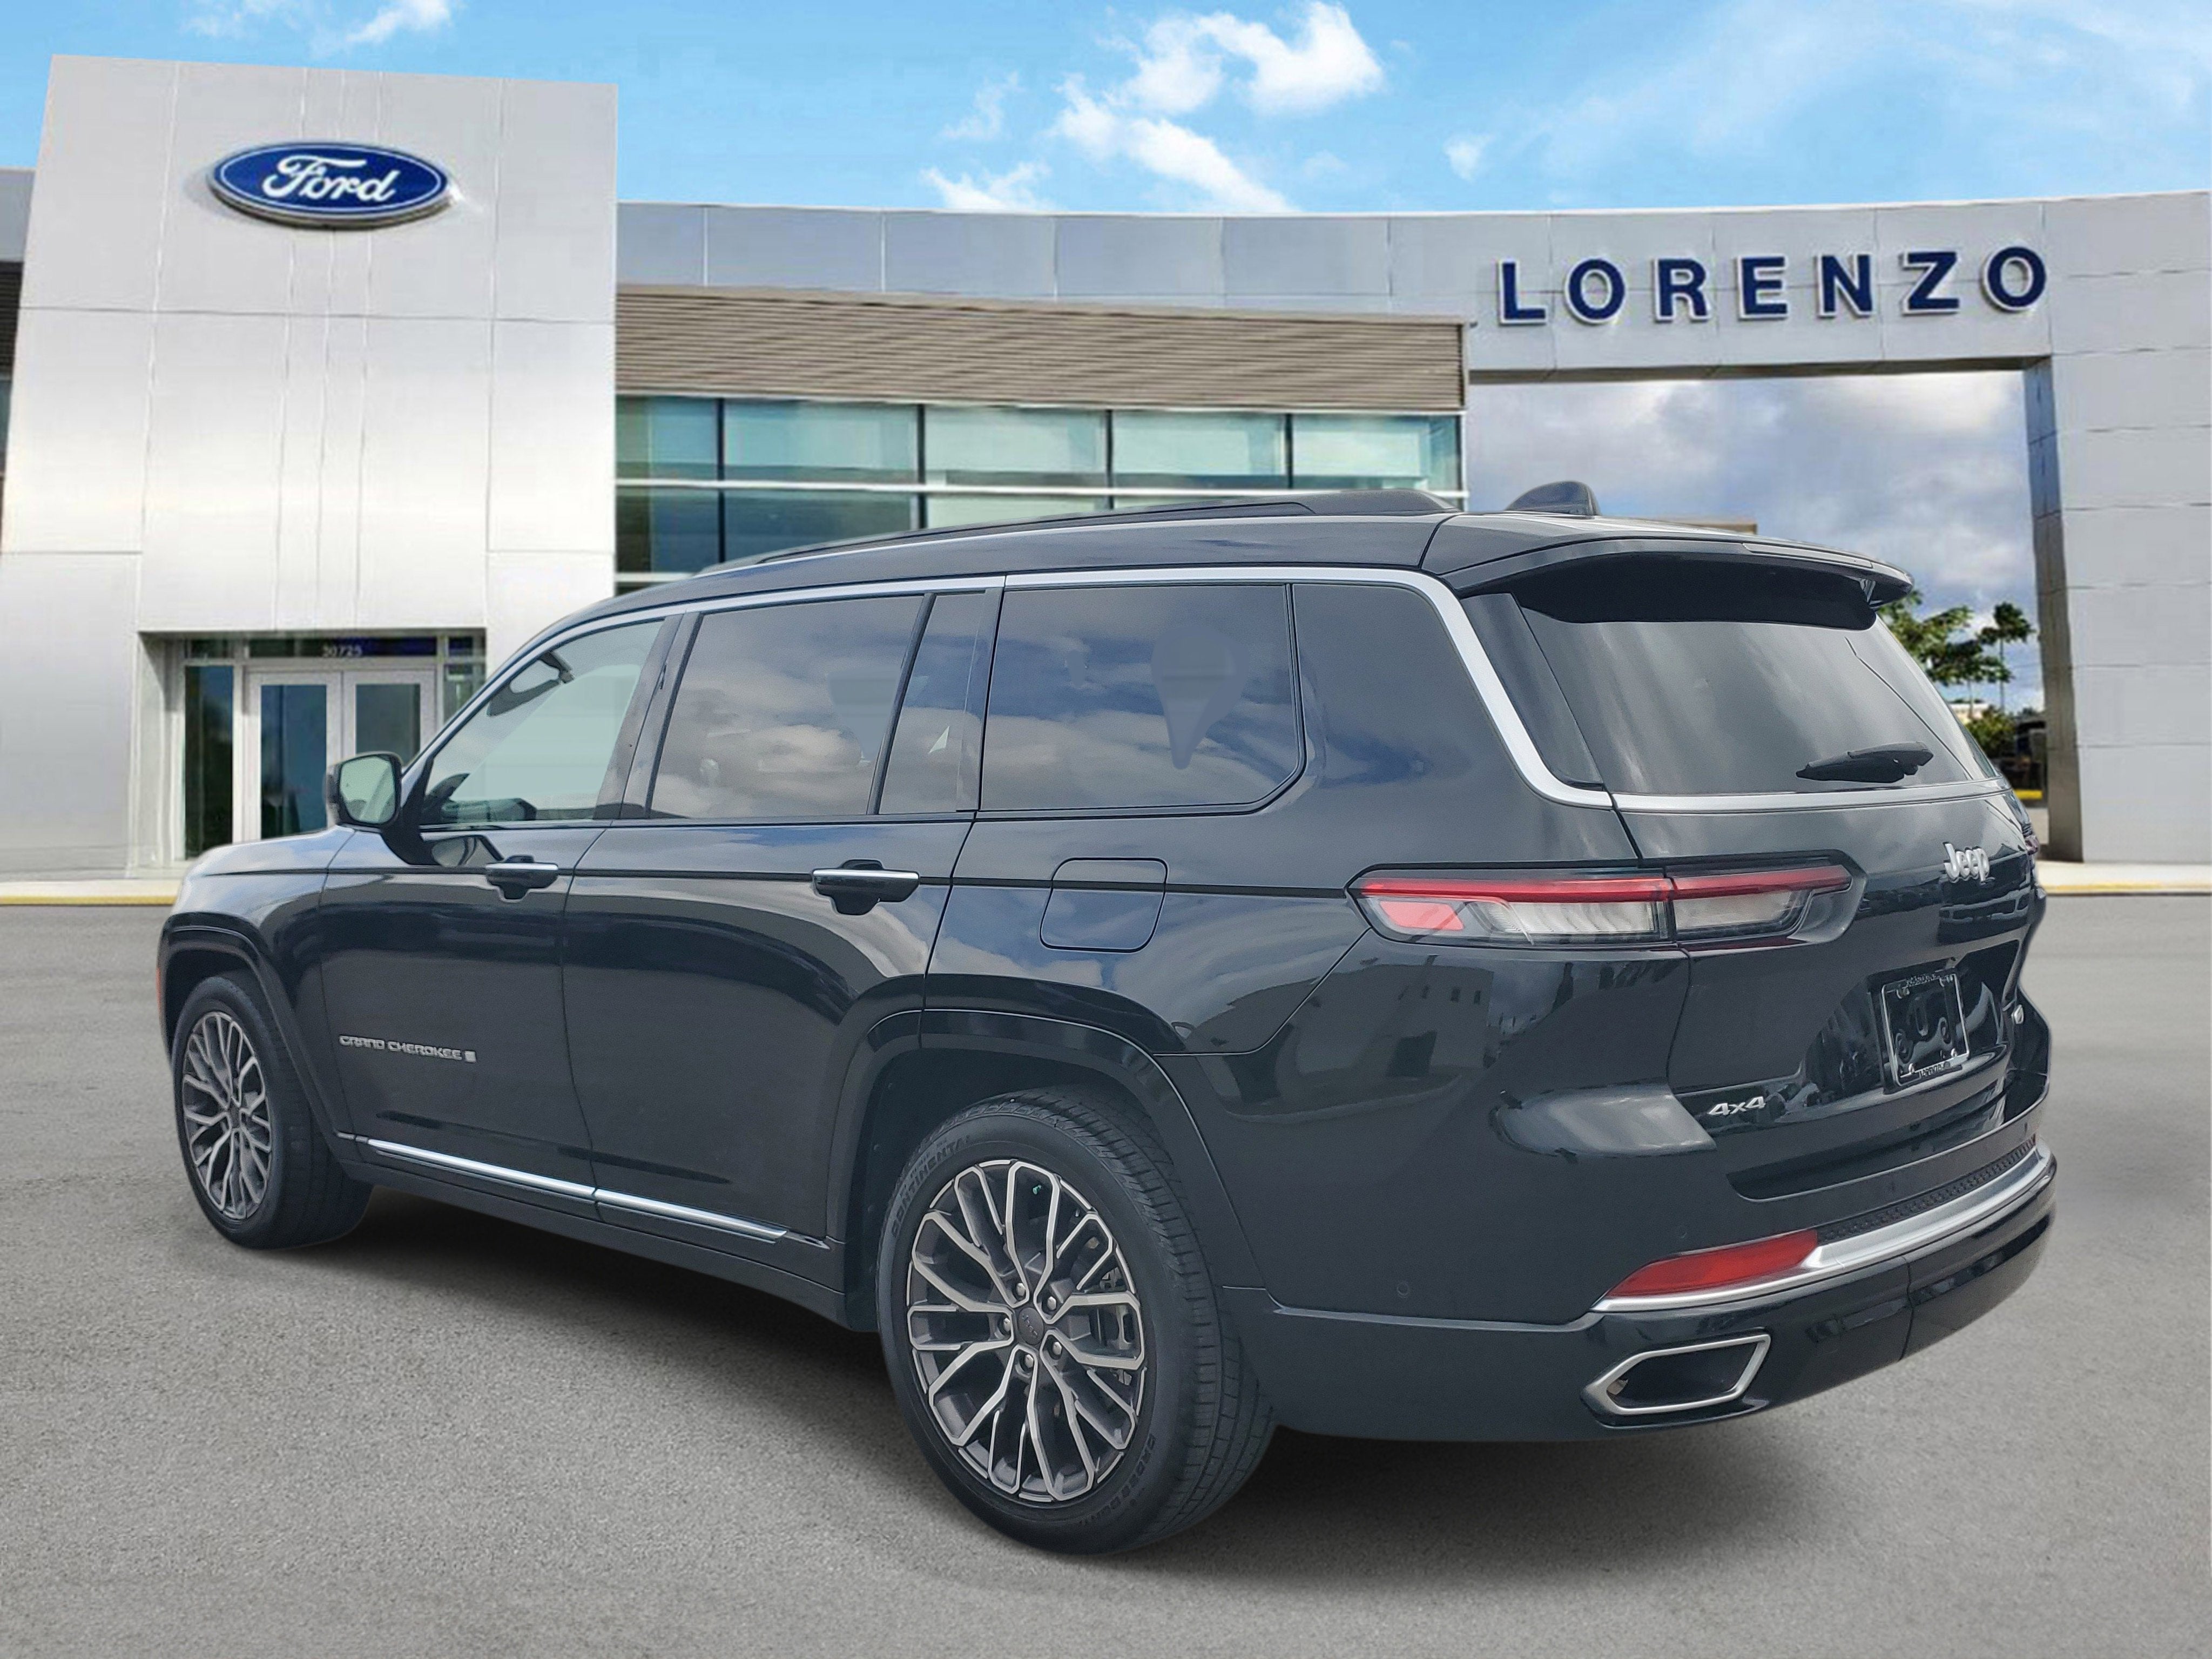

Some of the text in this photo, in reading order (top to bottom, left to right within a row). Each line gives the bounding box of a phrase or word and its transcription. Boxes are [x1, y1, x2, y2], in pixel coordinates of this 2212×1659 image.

[262, 154, 401, 201] Ford
[1496, 246, 2047, 324] LORENZO
[1943, 842, 1990, 882] Jeep
